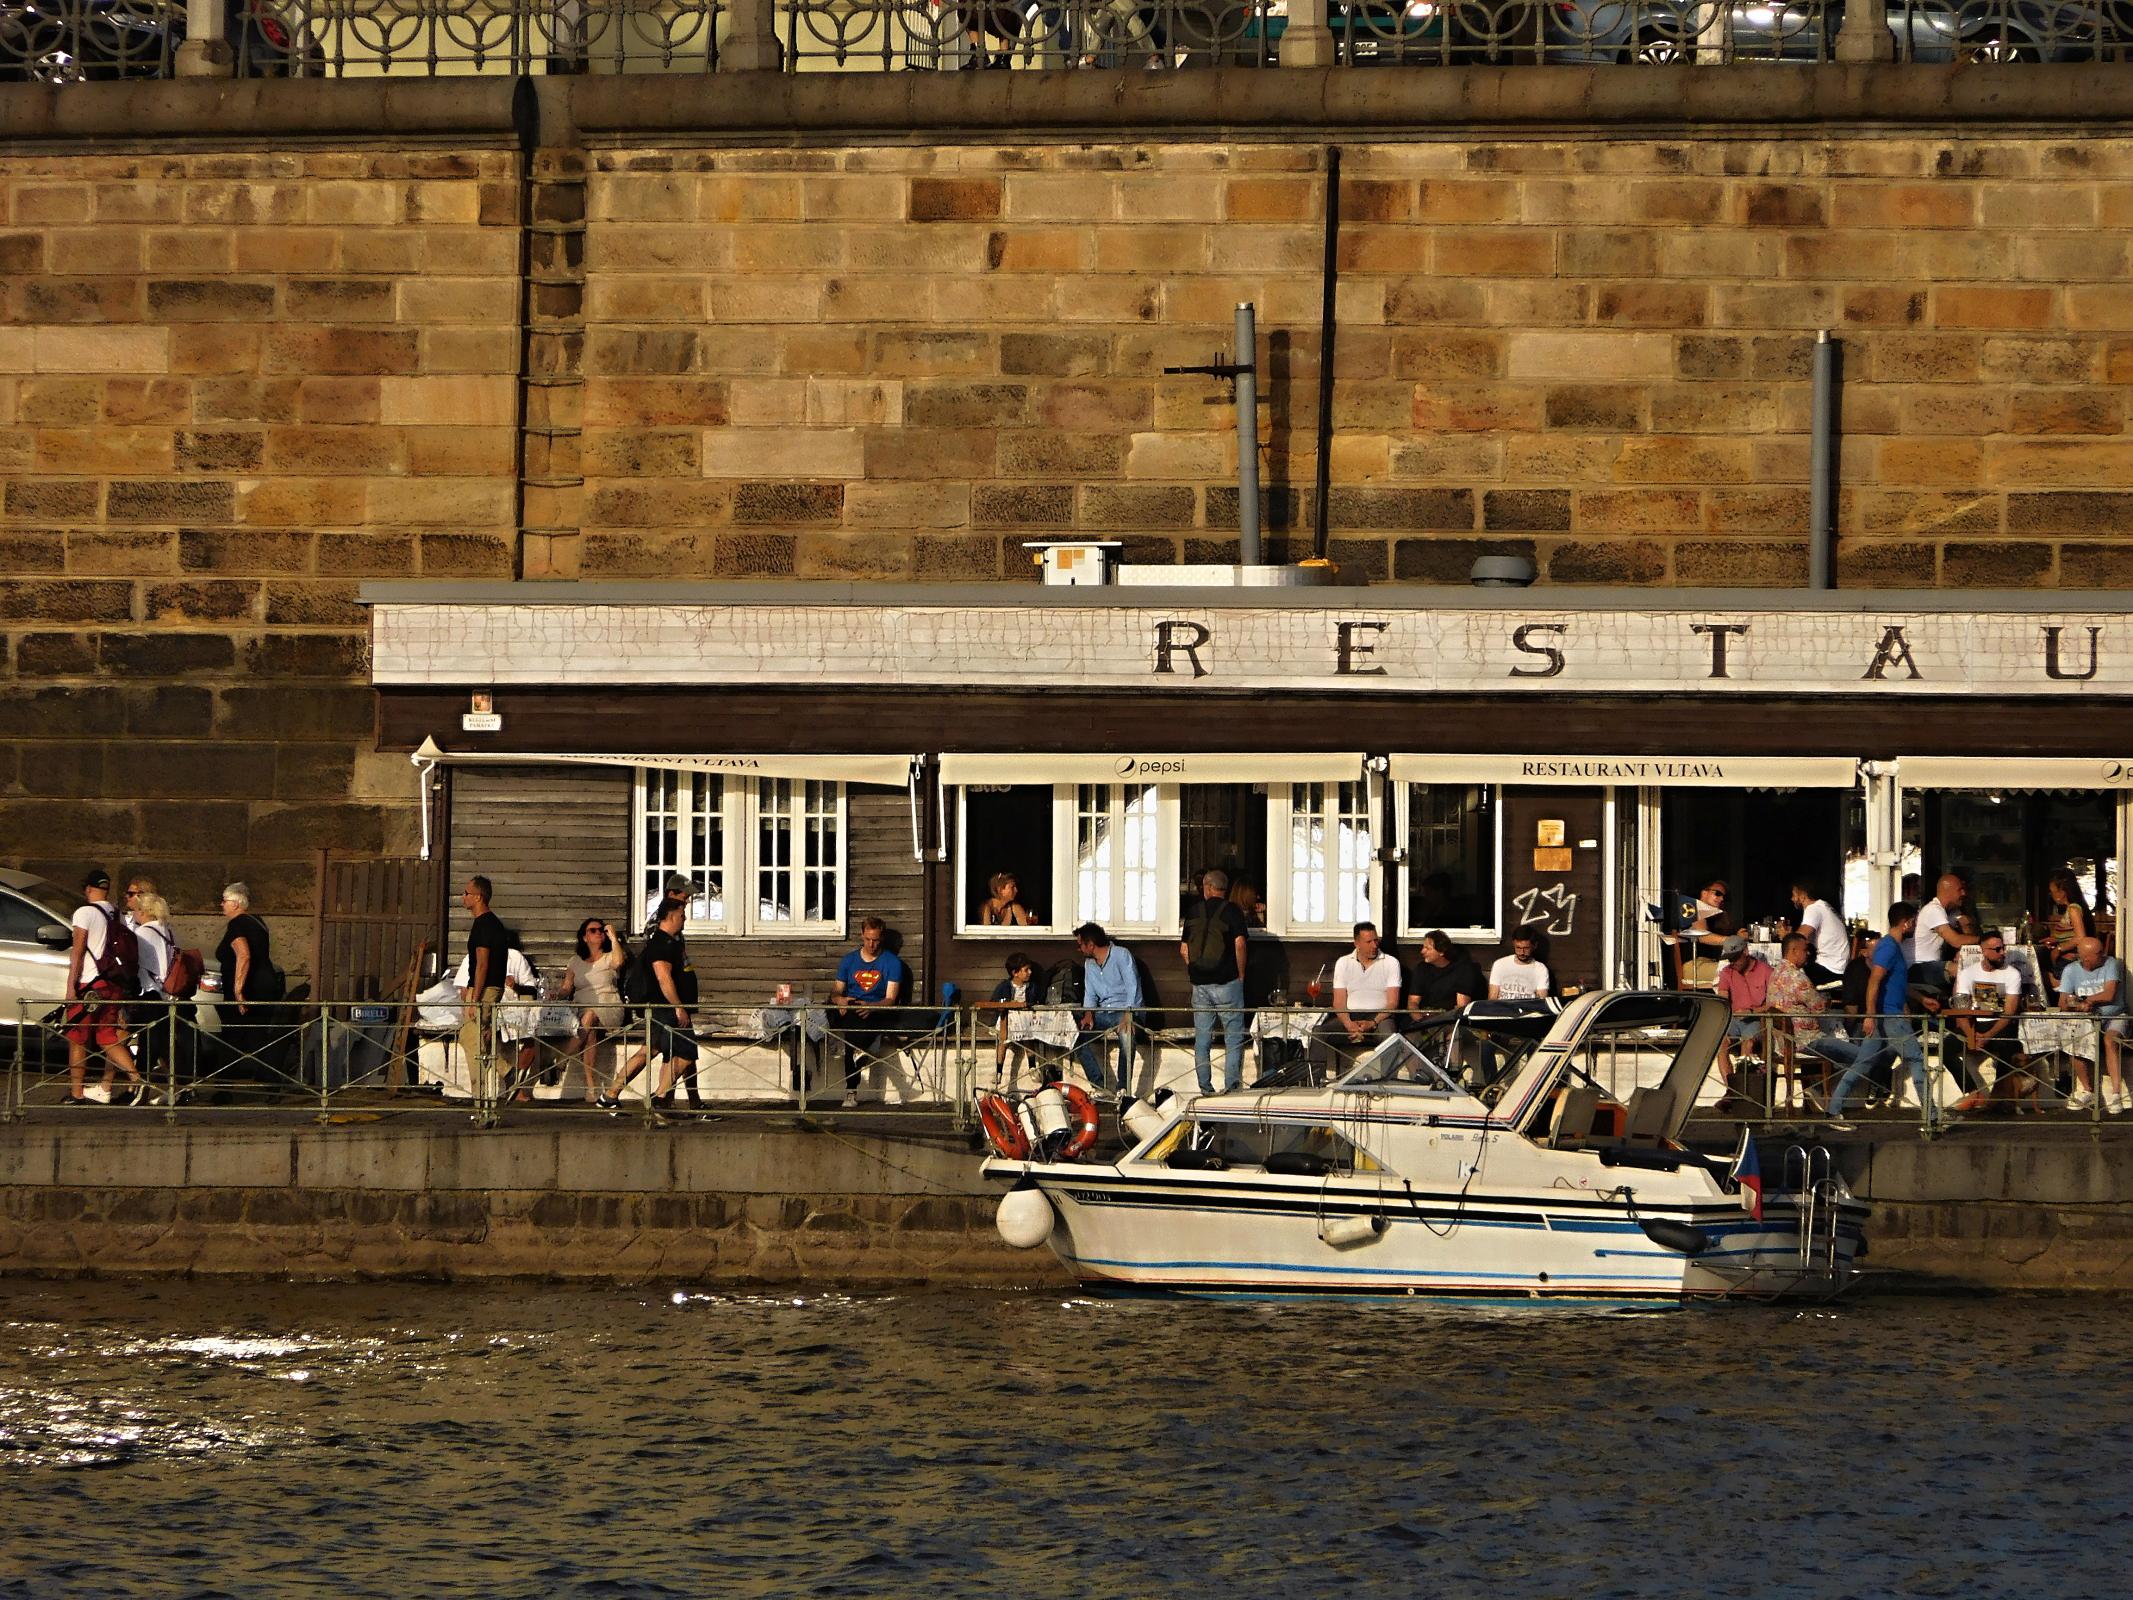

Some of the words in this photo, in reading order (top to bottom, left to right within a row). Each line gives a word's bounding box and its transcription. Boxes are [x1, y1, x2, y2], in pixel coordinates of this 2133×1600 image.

[692, 757, 760, 768] VLTAVA
[1139, 758, 1185, 776] pepsi
[1522, 761, 1650, 776] RESTAURANT
[1655, 763, 1724, 778] VLTAVA
